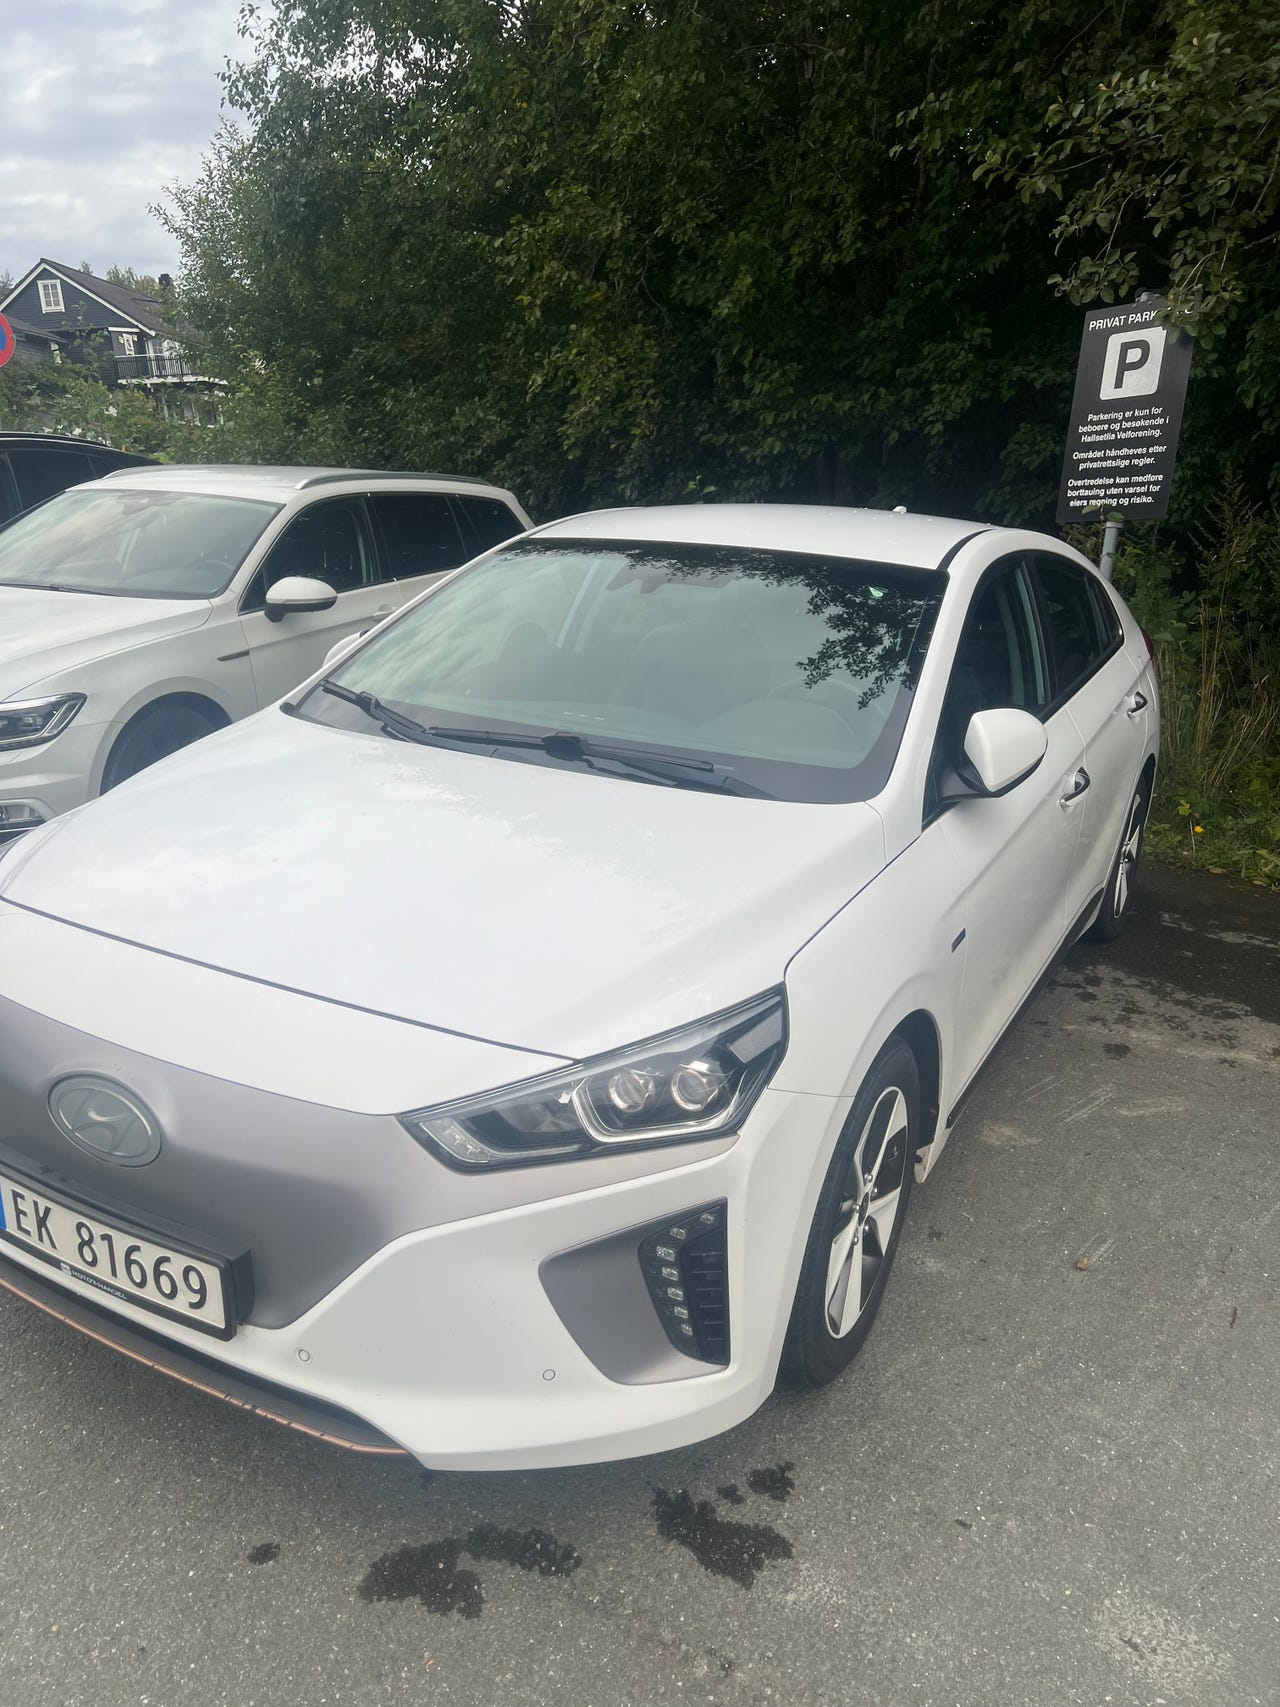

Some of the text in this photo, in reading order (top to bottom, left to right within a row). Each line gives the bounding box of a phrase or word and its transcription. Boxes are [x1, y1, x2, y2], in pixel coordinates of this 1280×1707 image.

[1089, 316, 1126, 331] PRIVAT
[1114, 340, 1150, 389] P
[1088, 411, 1123, 421] Parkering
[1079, 424, 1108, 432] beboere
[1110, 422, 1120, 431] og
[1122, 417, 1164, 428] besøkende
[1081, 428, 1162, 442] Hallsetlia Velforening.
[1073, 445, 1167, 459] Området håndheves etter
[1079, 456, 1155, 470] privatrettslige regler.
[1068, 476, 1114, 486] Overtredelse
[1131, 474, 1163, 482] medføre
[1067, 487, 1104, 496] borttauing
[1124, 485, 1147, 493] varsel
[1070, 495, 1154, 507] eiers regning og risiko.
[11, 1188, 207, 1309] EK 81669
